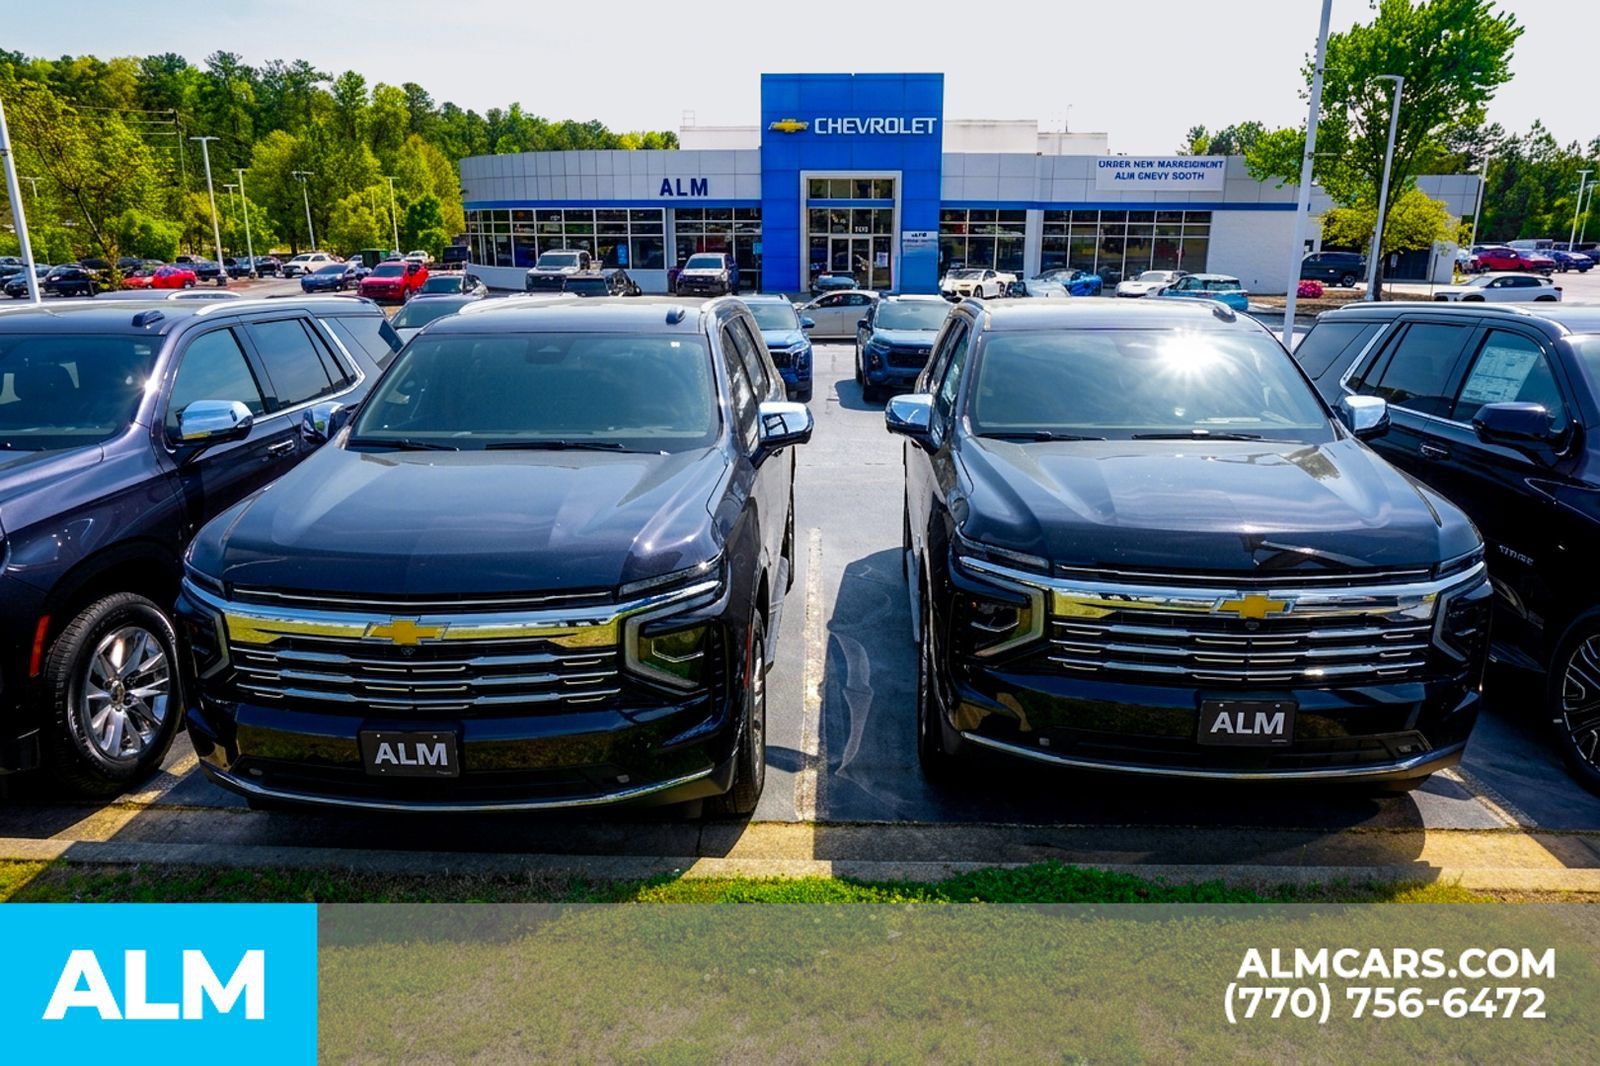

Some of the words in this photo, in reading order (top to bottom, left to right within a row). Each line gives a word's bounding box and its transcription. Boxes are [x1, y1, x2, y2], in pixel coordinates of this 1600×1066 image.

[814, 117, 937, 135] CHEVROLET
[1133, 160, 1155, 169] NEW
[660, 178, 708, 196] ALM
[1210, 712, 1285, 735] ALM
[374, 742, 448, 766] ALM
